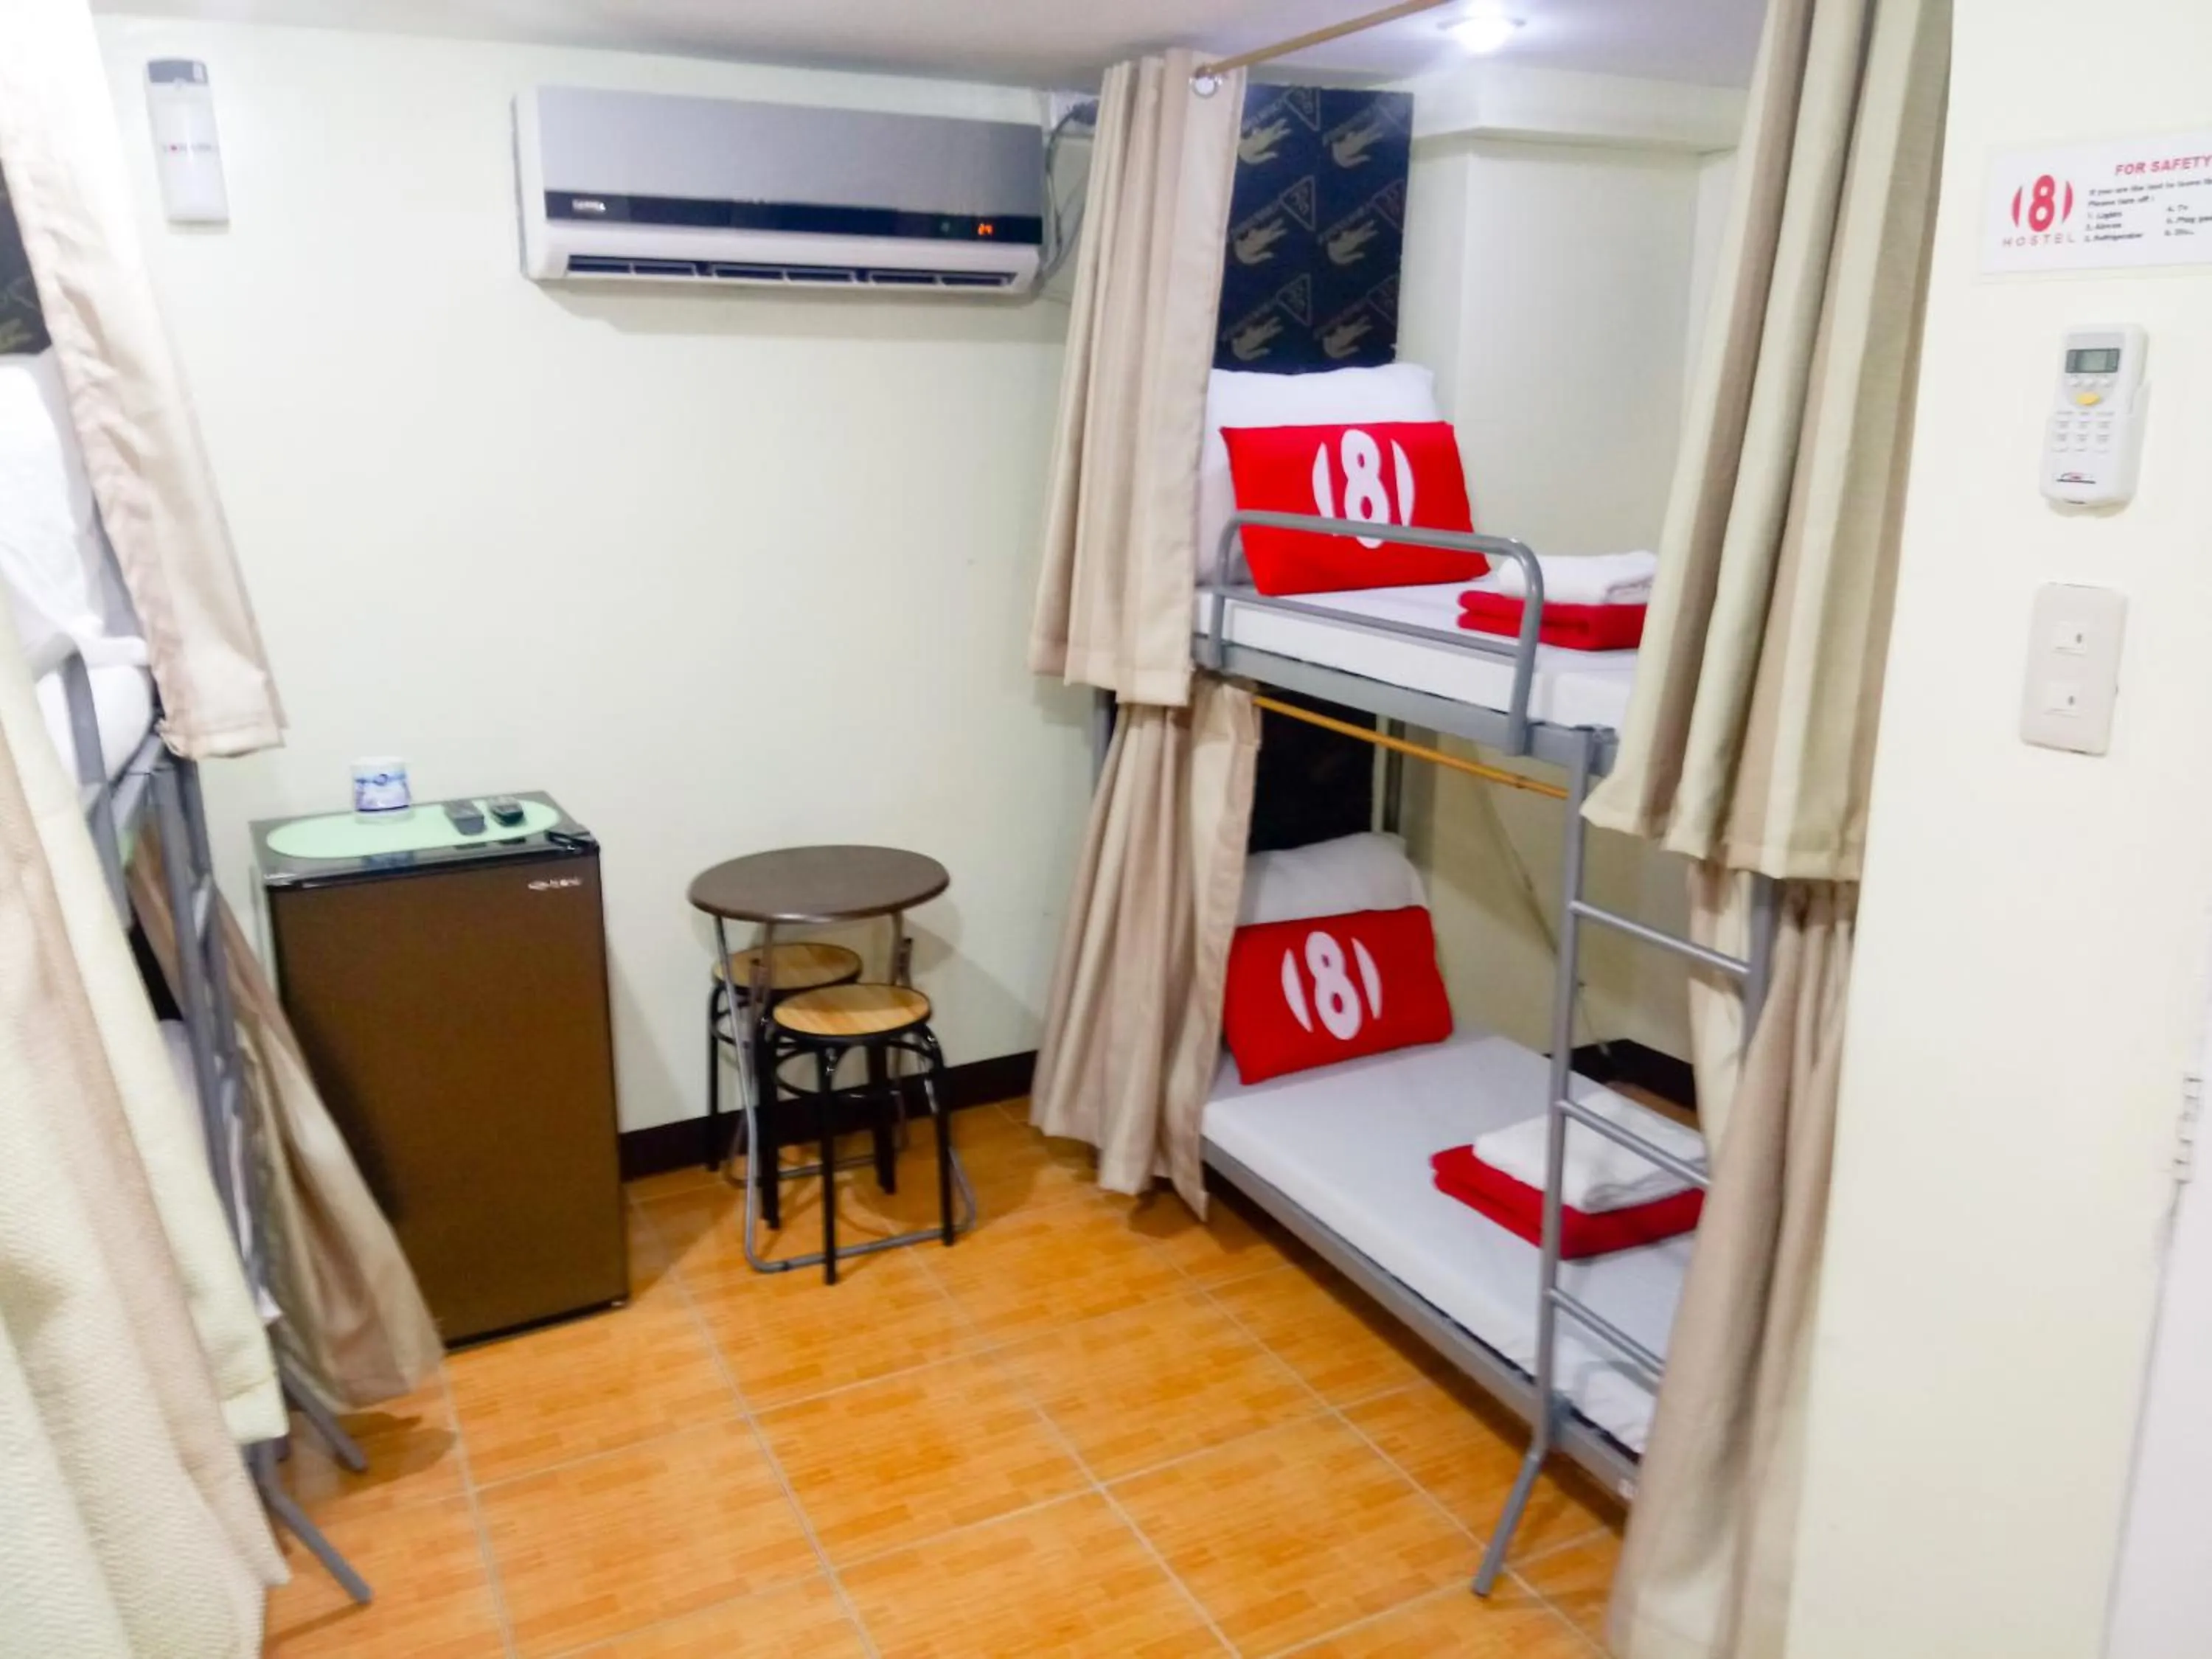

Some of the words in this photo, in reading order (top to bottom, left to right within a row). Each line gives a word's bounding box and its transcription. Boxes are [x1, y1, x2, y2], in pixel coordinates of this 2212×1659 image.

[2115, 161, 2146, 175] FOR
[2150, 155, 2212, 172] SAFETY
[2003, 233, 2076, 247] HOSTEL
